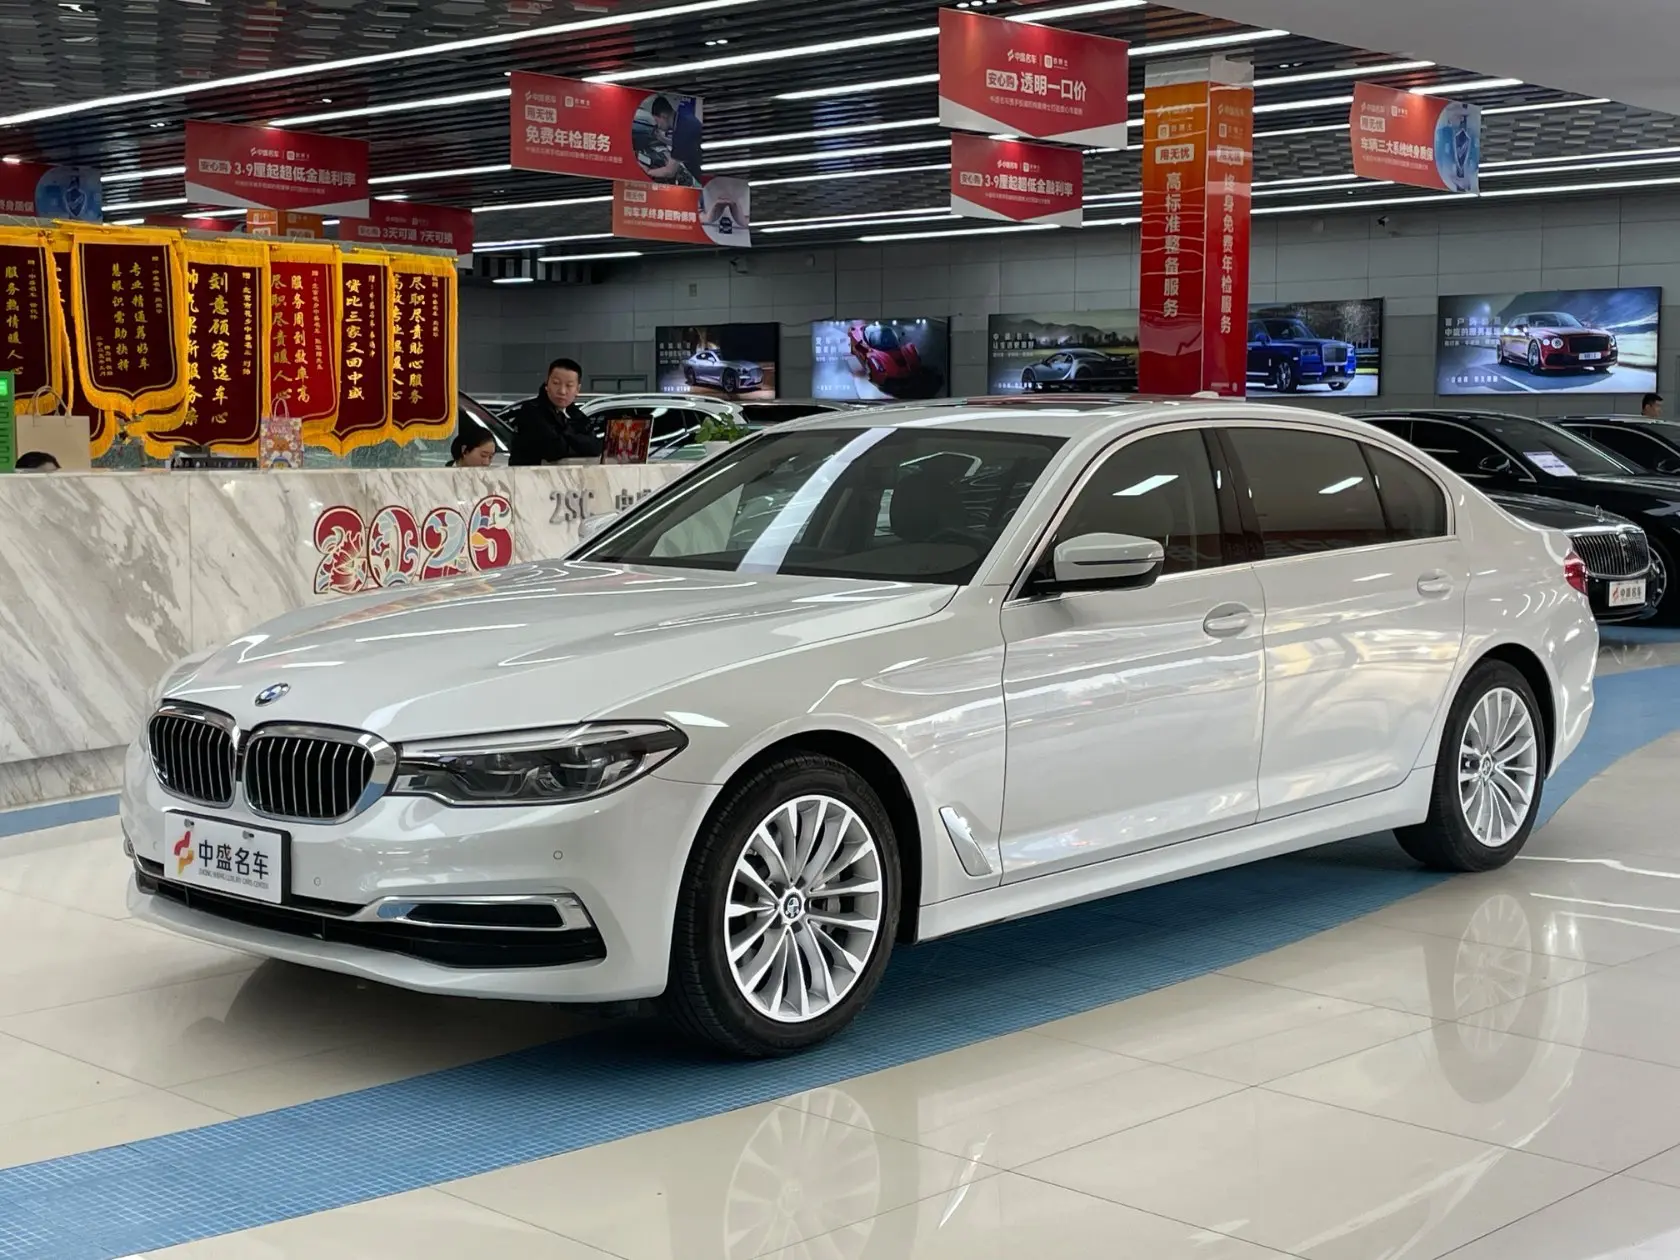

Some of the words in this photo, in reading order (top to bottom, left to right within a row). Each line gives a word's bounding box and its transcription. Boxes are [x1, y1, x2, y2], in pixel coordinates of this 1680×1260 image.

[525, 125, 611, 153] 免费年检服务
[988, 72, 1015, 89] 安心购
[1020, 71, 1087, 102] 透明一口价
[1160, 147, 1190, 161] 用无忧
[1163, 171, 1182, 319] 高标准整备服务
[1219, 171, 1236, 335] 终身免费年检服务
[5, 266, 24, 376] 服务热情暖人心
[208, 271, 232, 424] 刻意顾客选车心
[271, 274, 293, 401] 尽职尽责暖人心
[291, 275, 311, 404] 服务周到效率高
[345, 278, 365, 401] 货比三家又回中盛
[408, 276, 427, 405] 尽职尽责贴心服务
[198, 839, 269, 880] 中盛名车
